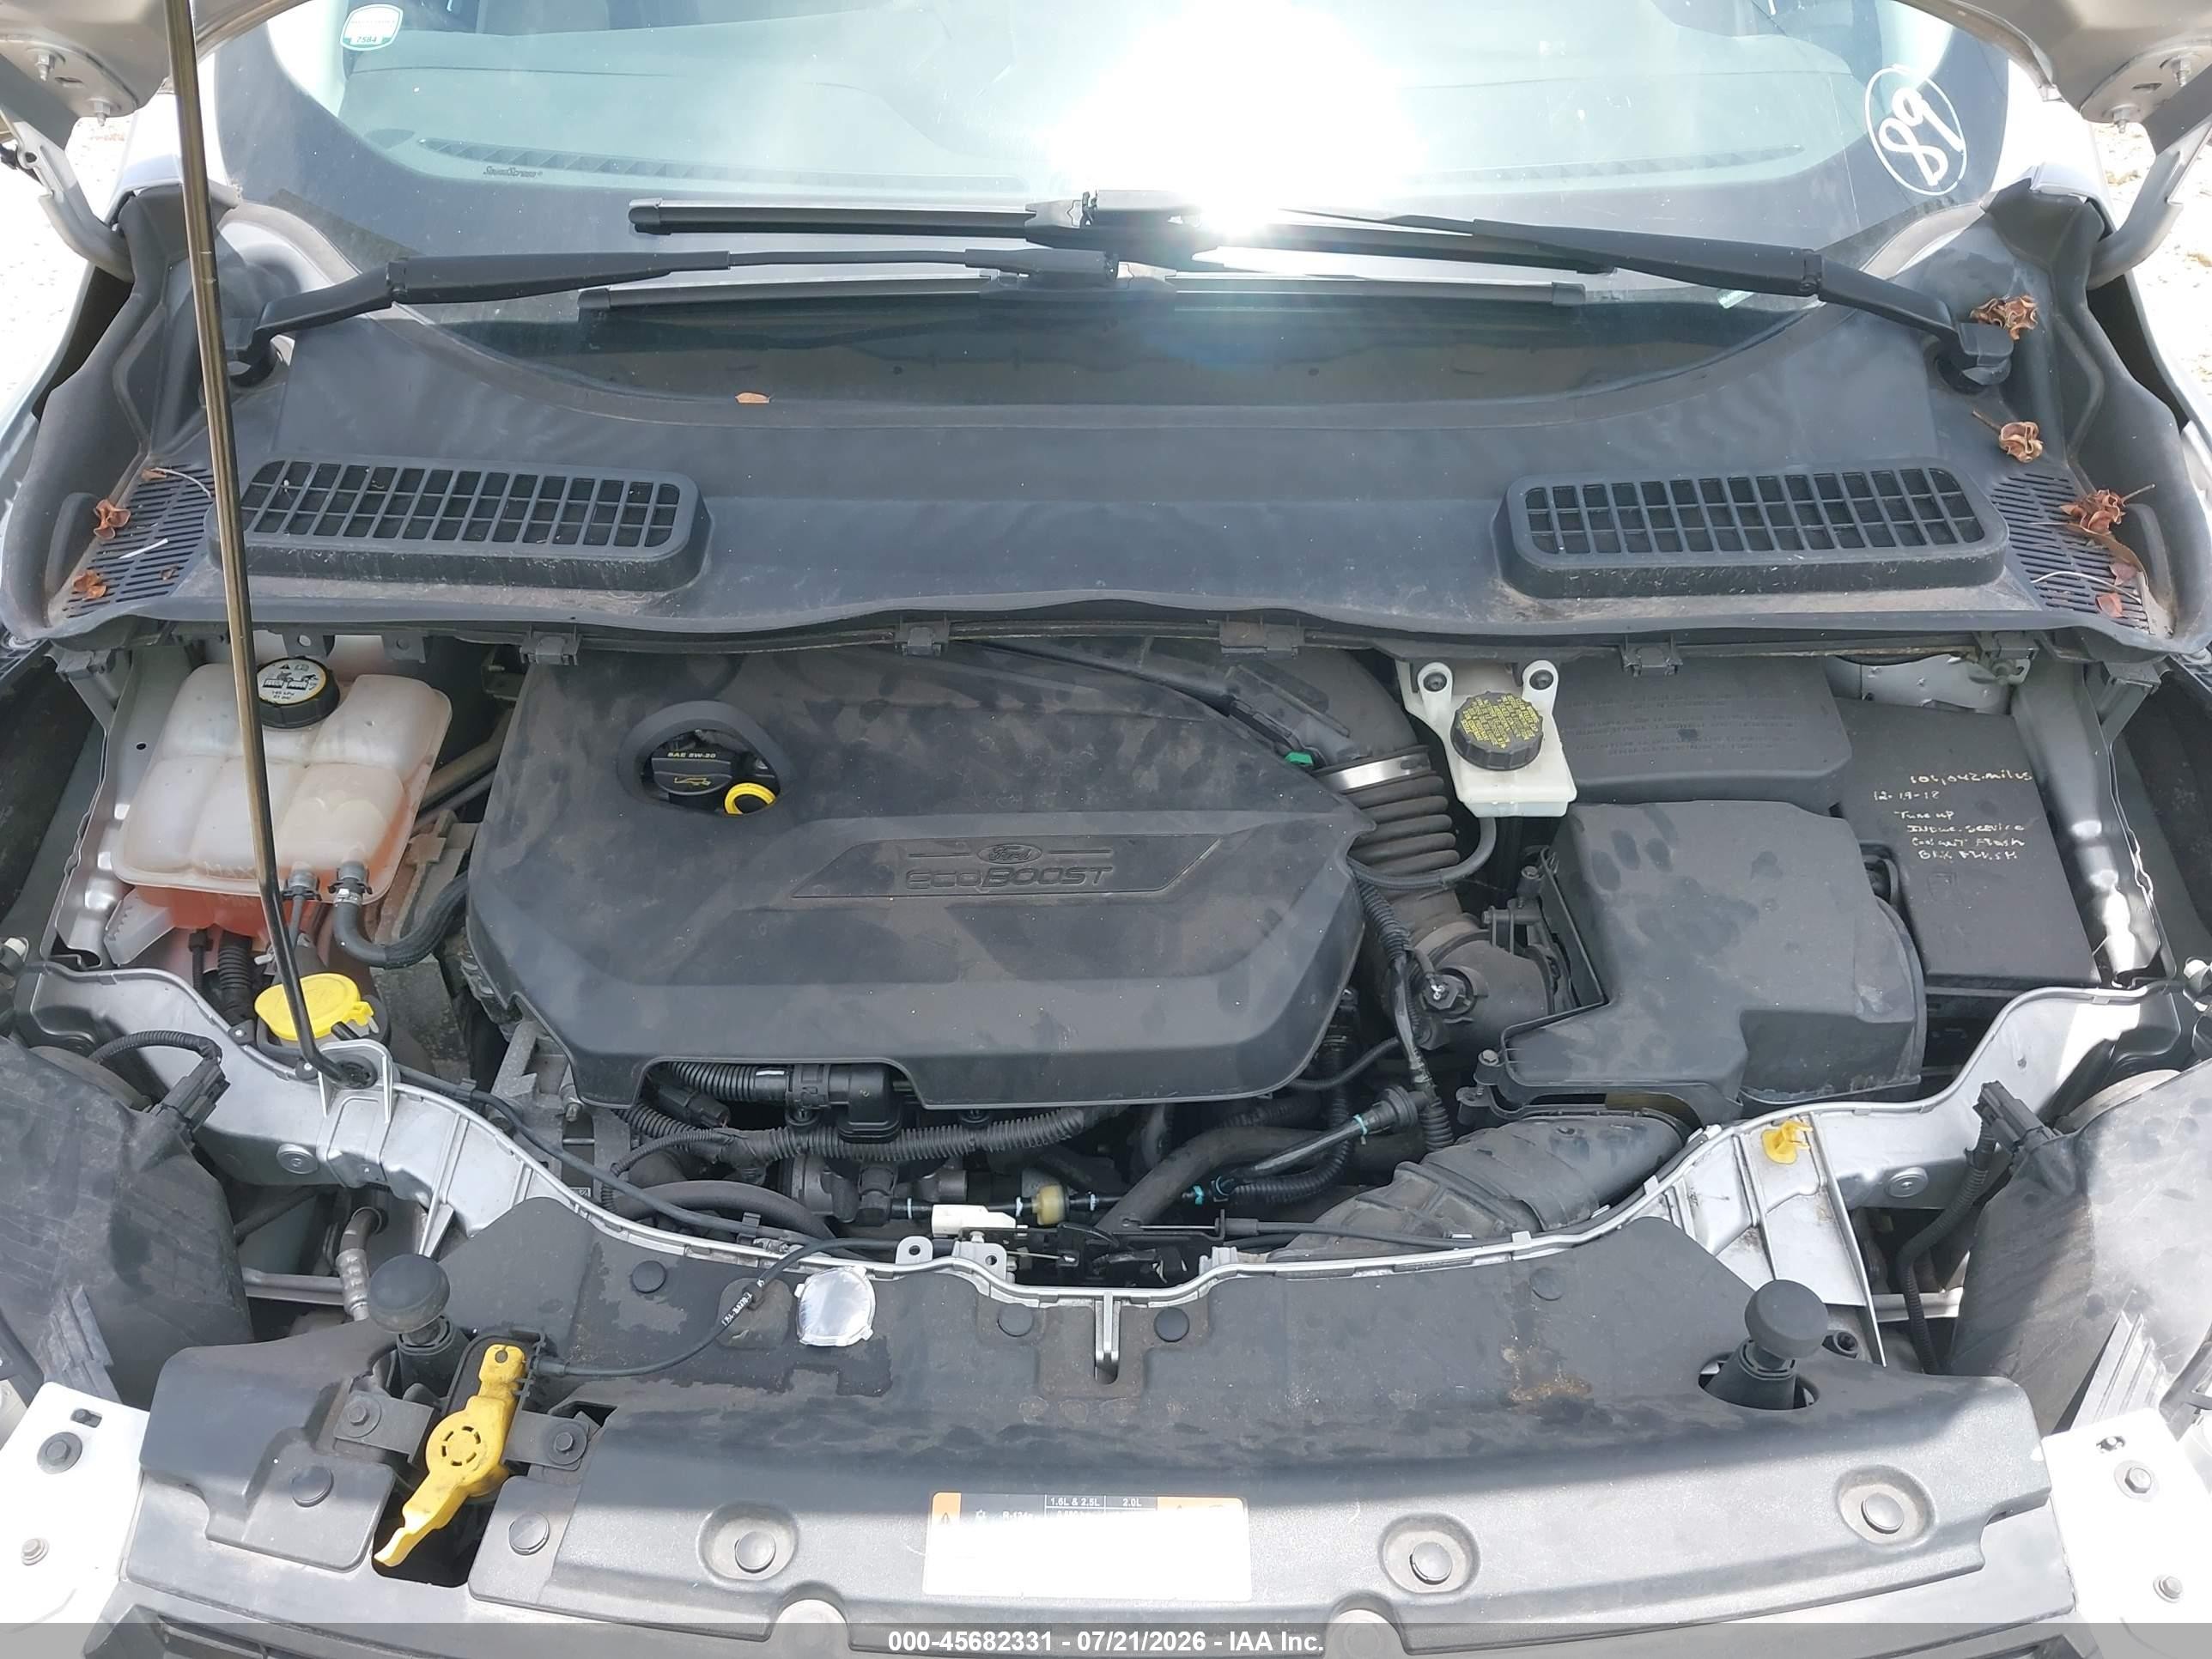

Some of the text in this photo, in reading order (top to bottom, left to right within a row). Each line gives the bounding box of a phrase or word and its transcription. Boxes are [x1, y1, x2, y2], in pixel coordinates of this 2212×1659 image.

[988, 845, 1032, 862] Ford
[1050, 1498, 1069, 1506] 1.6L
[1080, 1498, 1100, 1506] 2.5L
[1122, 1498, 1142, 1506] 2.0L
